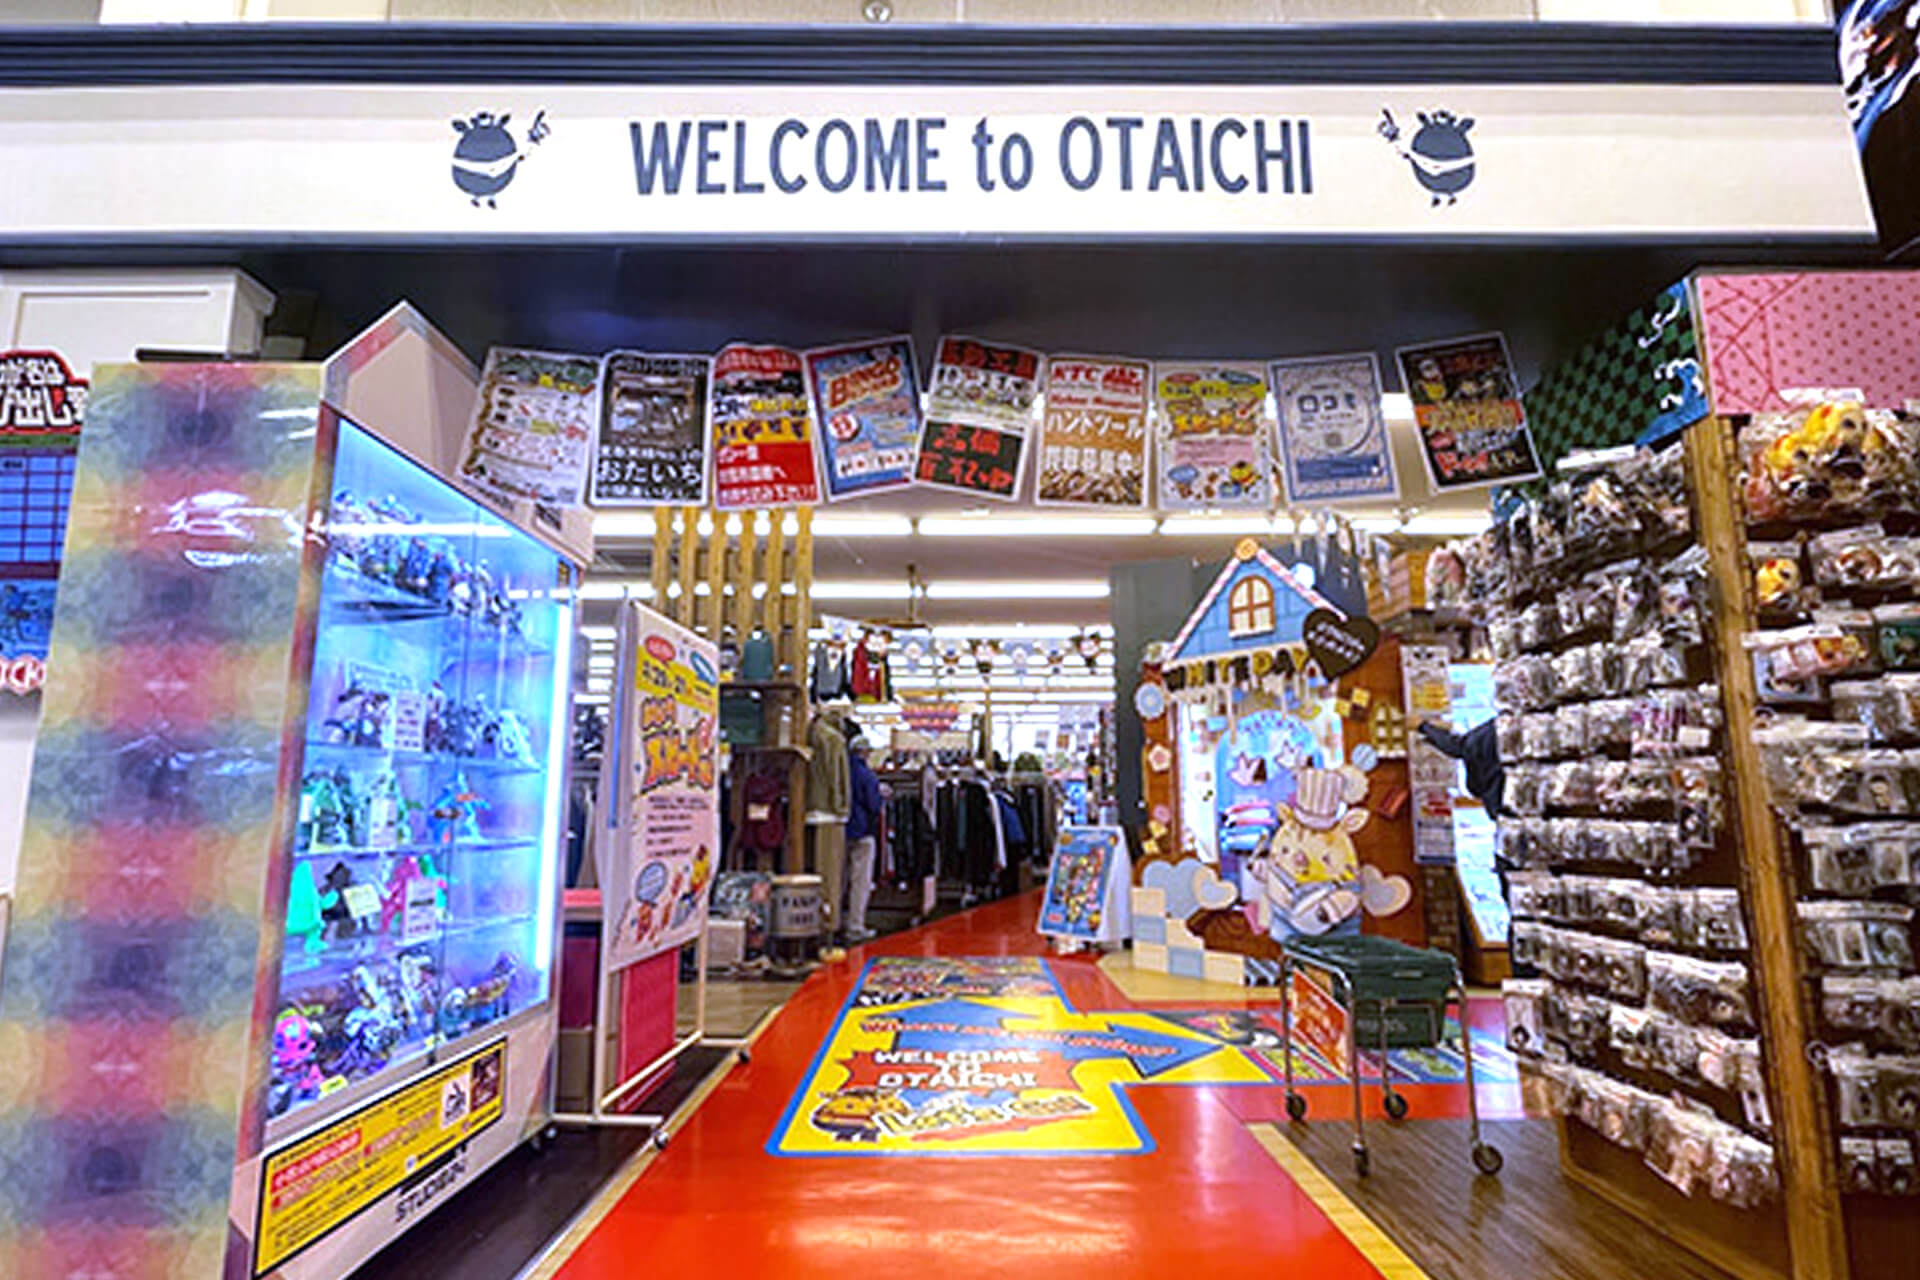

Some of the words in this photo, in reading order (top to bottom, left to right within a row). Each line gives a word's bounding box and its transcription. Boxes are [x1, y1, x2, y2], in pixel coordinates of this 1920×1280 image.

[629, 118, 947, 195] WELCOME
[971, 117, 1033, 192] to
[1059, 116, 1313, 195] OTAICHI
[598, 460, 701, 484] おたいち
[1164, 656, 1249, 692] WHITE
[1251, 647, 1309, 681] DAY
[875, 1050, 1041, 1064] WELCOME
[934, 1059, 981, 1073] TO
[878, 1072, 1038, 1087] OTAICHI
